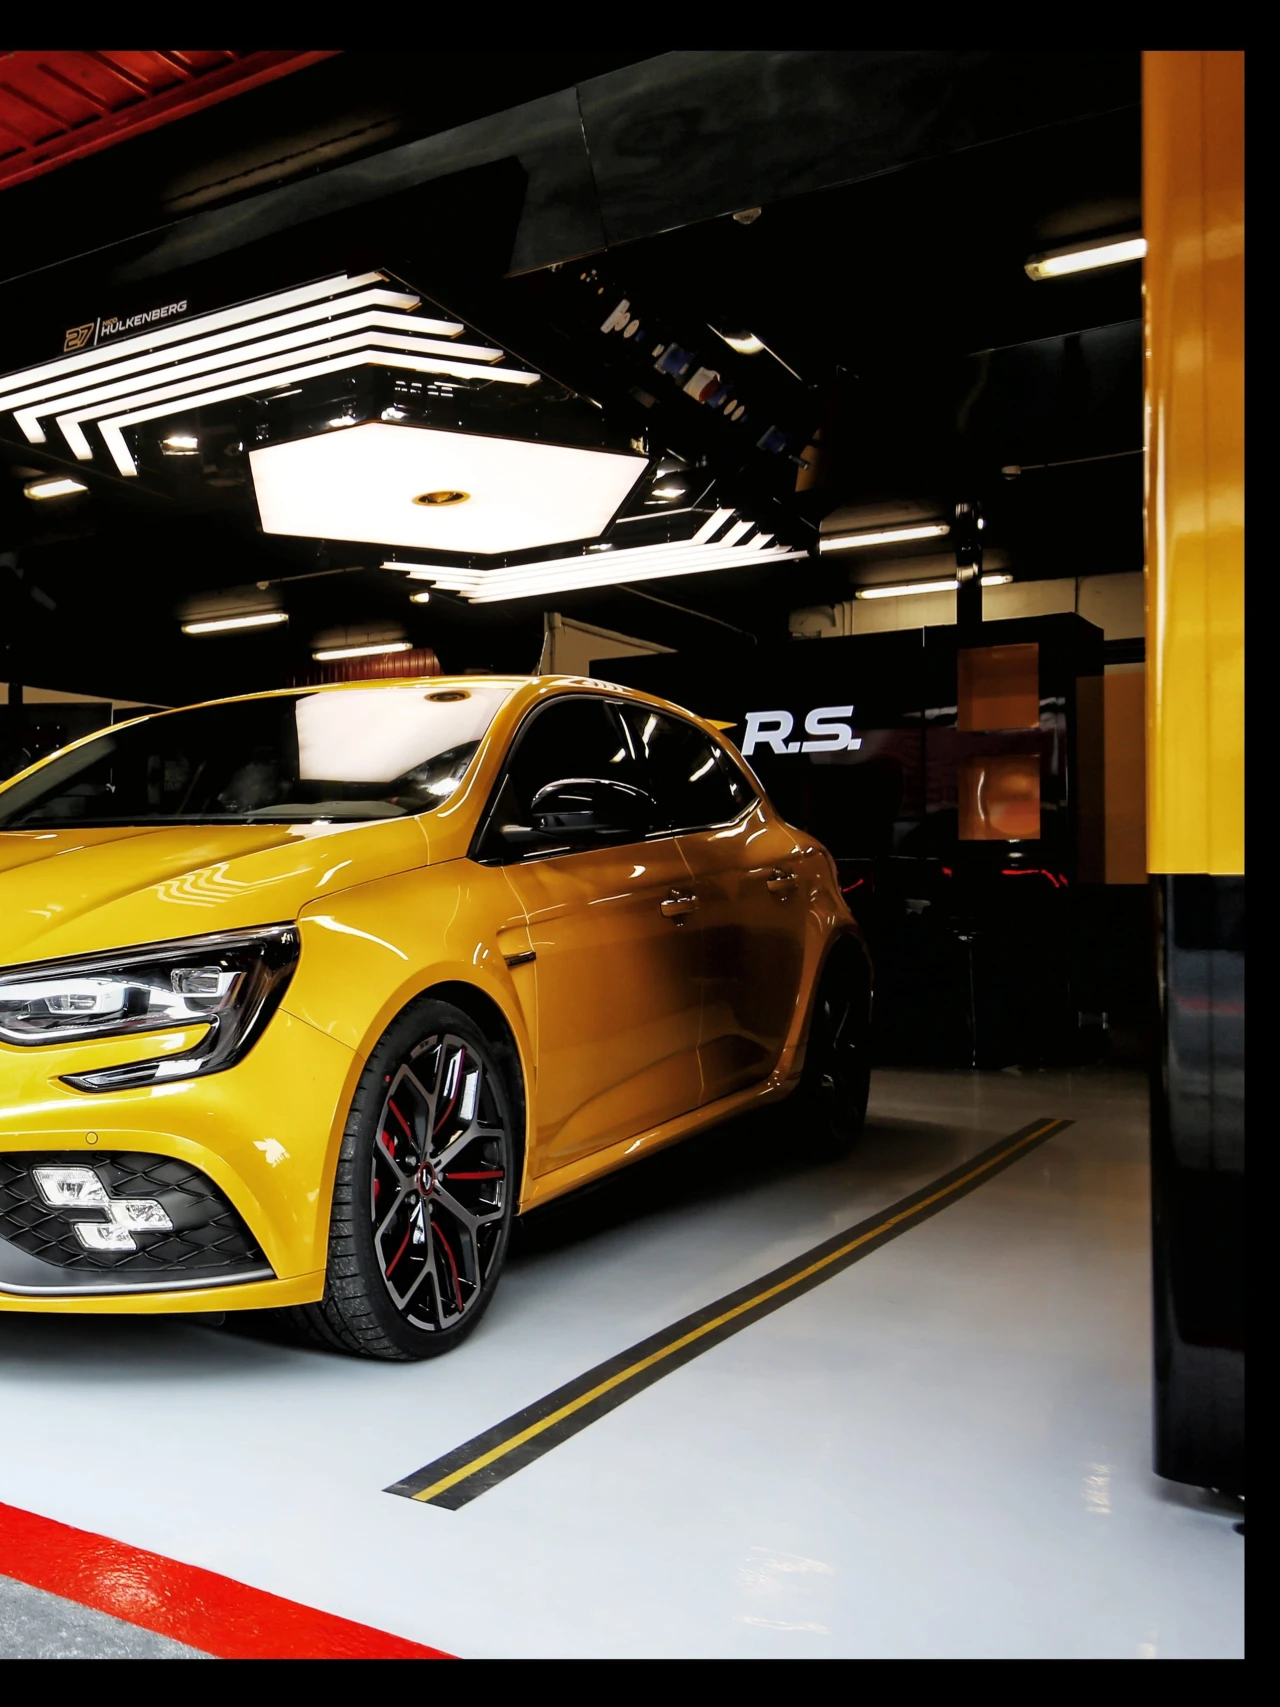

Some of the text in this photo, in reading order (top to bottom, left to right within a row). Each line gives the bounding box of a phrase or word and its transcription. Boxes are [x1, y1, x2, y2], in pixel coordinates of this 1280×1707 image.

[64, 300, 188, 352] 27 HULKENBERG
[741, 705, 862, 755] R.S.
